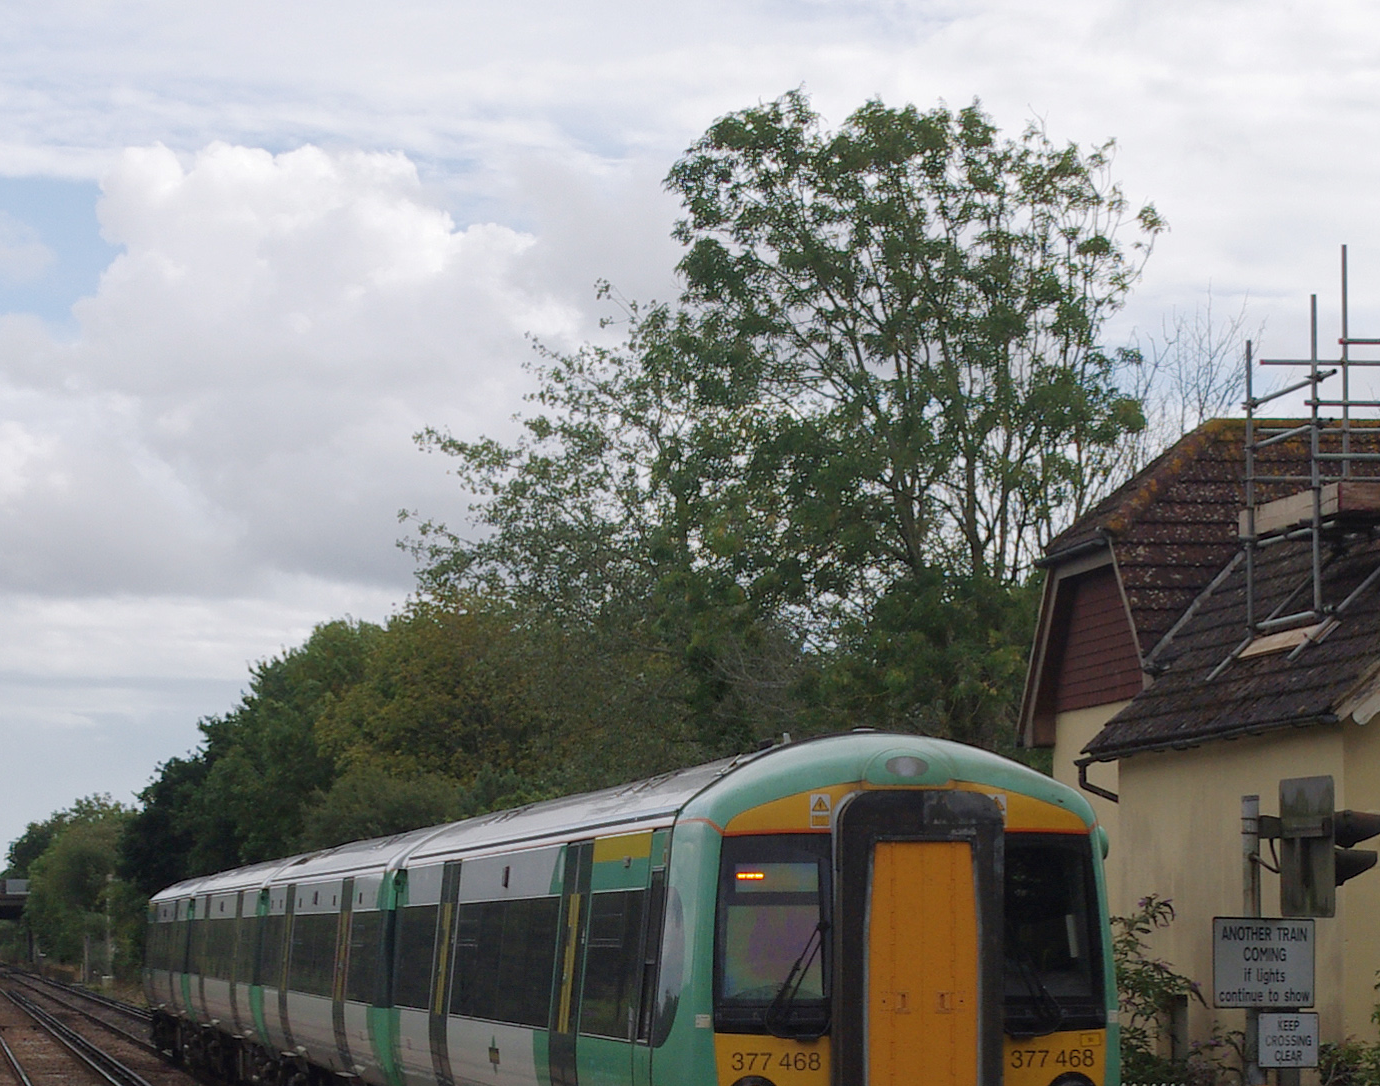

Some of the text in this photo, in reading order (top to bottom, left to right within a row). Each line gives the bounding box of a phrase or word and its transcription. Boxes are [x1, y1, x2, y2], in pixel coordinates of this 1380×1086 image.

[1221, 926, 1308, 942] ANOTHER TRAIN
[1243, 946, 1287, 962] COMING
[1243, 967, 1286, 985] if lights
[1219, 987, 1310, 1002] continue to show
[1277, 1019, 1300, 1032] KEEP
[1265, 1034, 1312, 1047] CROSSING
[731, 1052, 821, 1071] 377 468
[1010, 1048, 1095, 1069] 377 468
[1274, 1050, 1303, 1062] CLEAR
